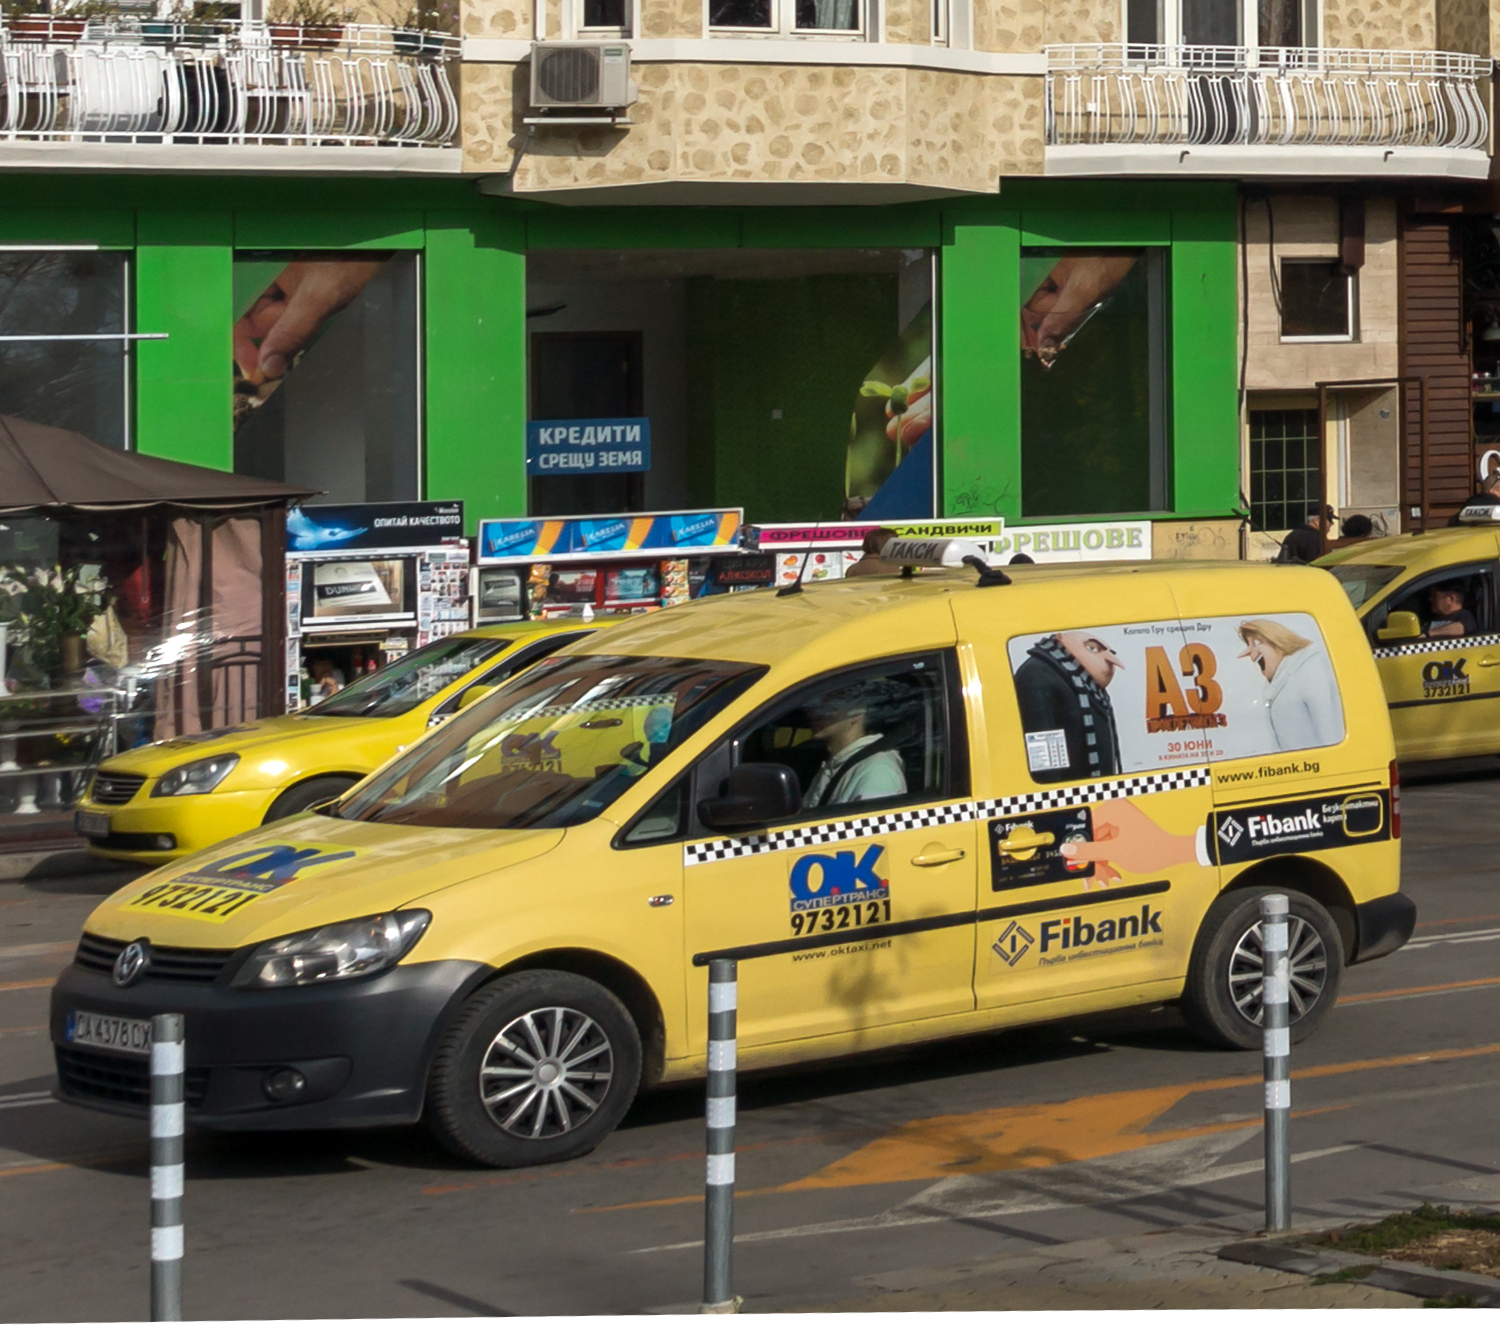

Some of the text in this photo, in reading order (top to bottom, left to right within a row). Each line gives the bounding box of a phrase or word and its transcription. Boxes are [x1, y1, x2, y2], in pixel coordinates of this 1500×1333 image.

[539, 425, 641, 445] КРЕДИТИ
[539, 450, 642, 471] СРЕЩУ ЗЕМЯ
[898, 524, 992, 536] САНДВИЧИ
[889, 541, 939, 559] ТАКСИ
[1167, 740, 1213, 753] 30 ЮНИ
[1217, 760, 1320, 784] www.fibank.bg
[1248, 809, 1321, 838] Fibank
[130, 883, 258, 917] 9732121
[793, 887, 887, 911] СУПЕРТРАНС
[791, 899, 891, 936] 9732121
[1040, 904, 1162, 953] Fibank
[792, 939, 892, 962] www.oktaxi.net
[94, 1018, 129, 1047] 4378
